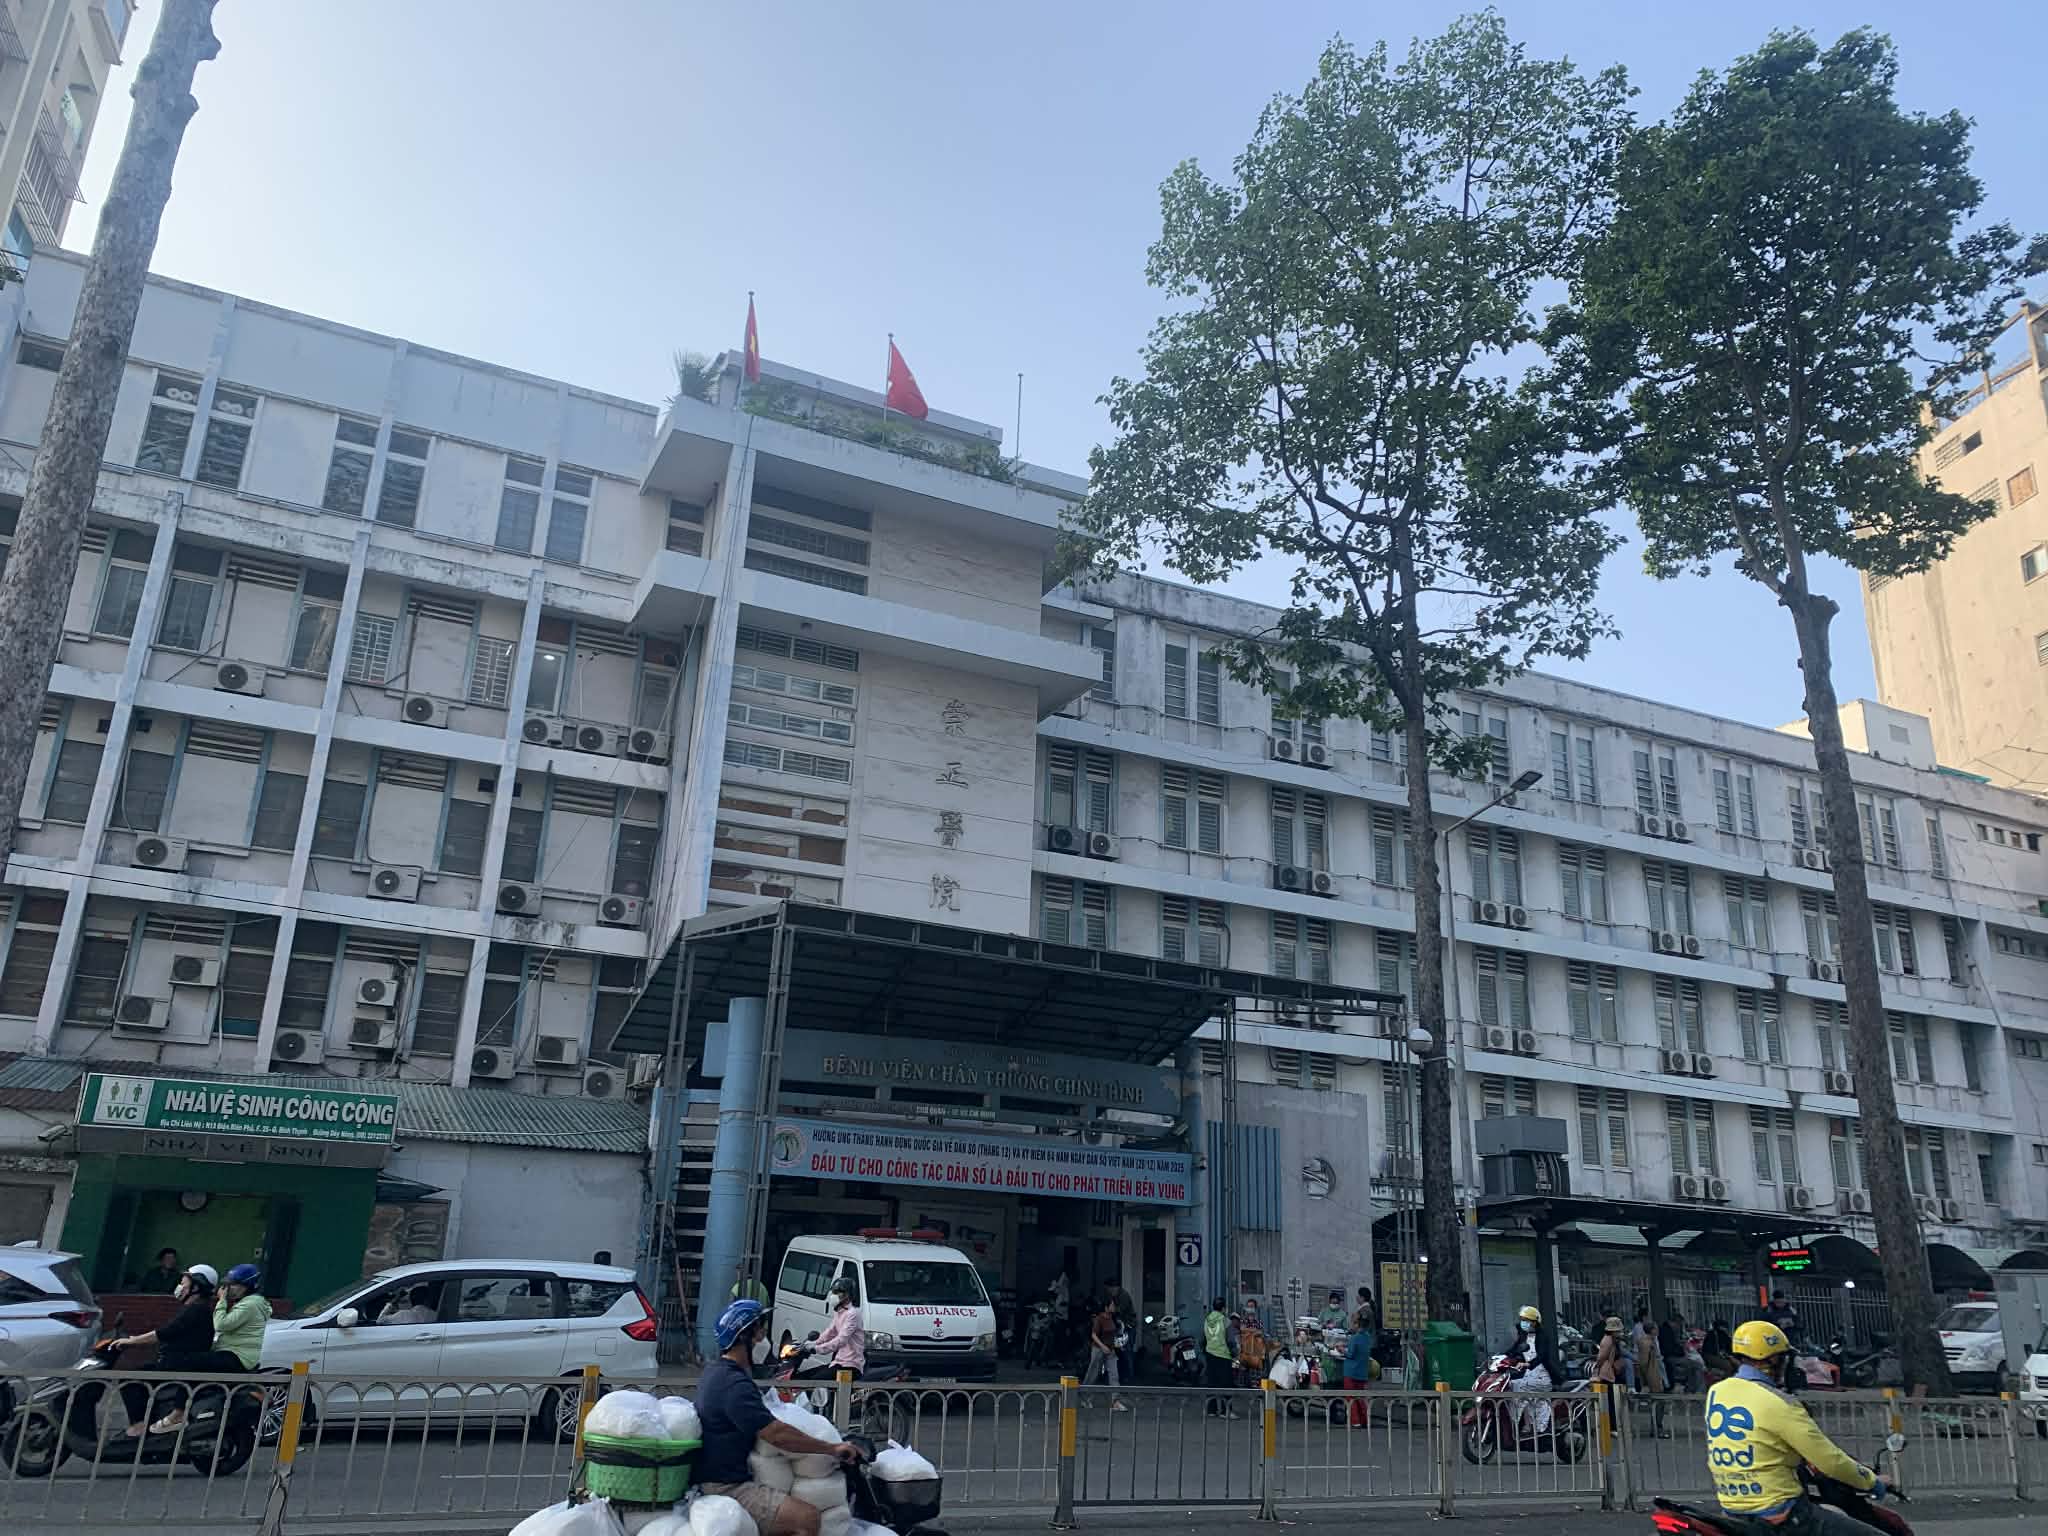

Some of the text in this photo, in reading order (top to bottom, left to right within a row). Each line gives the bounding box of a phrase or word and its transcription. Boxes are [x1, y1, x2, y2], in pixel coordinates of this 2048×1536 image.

[881, 1058, 924, 1082] VIỆN
[106, 1105, 138, 1119] WC
[164, 1086, 394, 1129] NHÀ VỆ SINH CÔNG CỘNG
[811, 1149, 836, 1172] ĐẦU
[840, 1154, 856, 1174] TƯ
[859, 1157, 882, 1177] CHO
[886, 1157, 918, 1179] CÔNG
[921, 1161, 943, 1181] TÁC
[946, 1162, 969, 1183] DÂN
[972, 1162, 988, 1184] SỐ
[1006, 1166, 1028, 1187] ĐẦU
[1031, 1169, 1046, 1189] TƯ
[1048, 1173, 1070, 1191] CHO
[1073, 1173, 1100, 1193] PHÁT
[1103, 1173, 1132, 1195] TRIỂN
[1135, 1176, 1155, 1197] BỀN
[1184, 1245, 1193, 1263] 1
[895, 1306, 978, 1318] AMBULANCE
[1707, 1391, 1754, 1440] be
